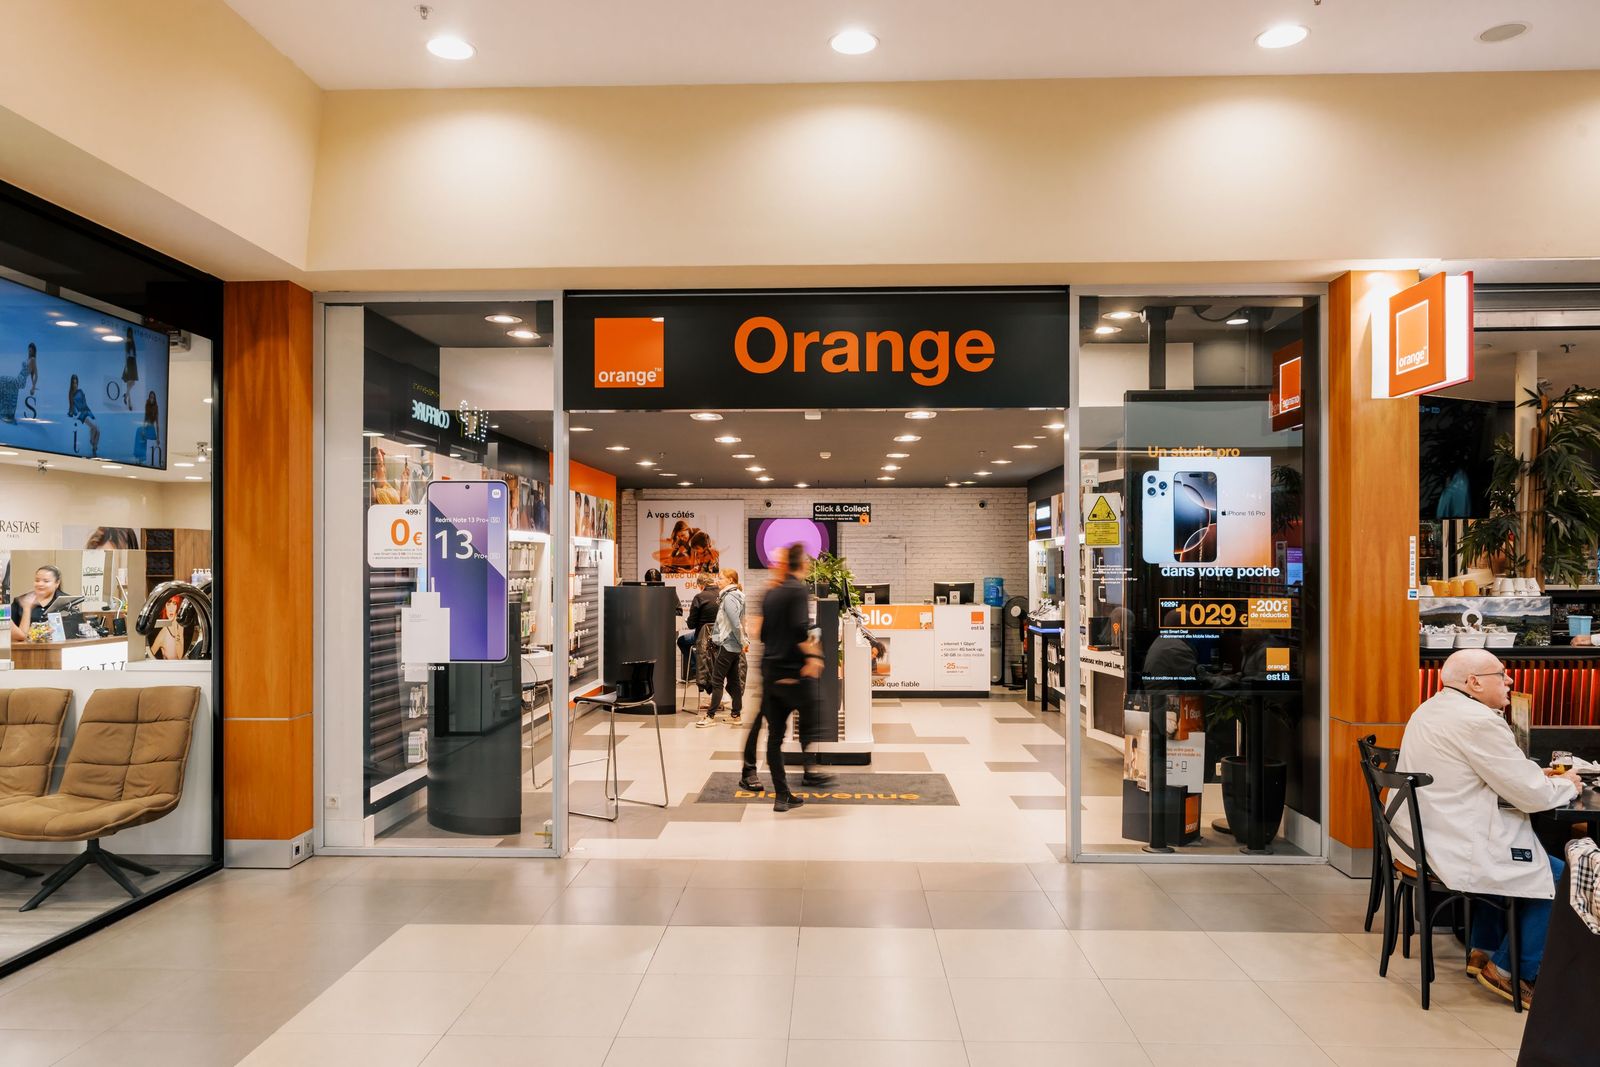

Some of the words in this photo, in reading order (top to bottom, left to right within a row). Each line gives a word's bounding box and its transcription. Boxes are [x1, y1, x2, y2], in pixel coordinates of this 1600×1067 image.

[734, 316, 996, 387] Orange
[1399, 350, 1424, 368] orange
[598, 369, 657, 386] orange
[1148, 445, 1165, 457] Un
[1170, 445, 1213, 457] studio
[1217, 447, 1240, 459] pro
[646, 509, 653, 518] À
[655, 511, 670, 519] vos
[671, 510, 695, 519] côtés
[815, 505, 834, 513] Click
[843, 505, 870, 513] Collect
[434, 529, 474, 560] 13
[1161, 566, 1195, 577] dans
[1198, 567, 1233, 577] votre
[1237, 565, 1280, 579] poche
[1251, 600, 1282, 612] -200
[861, 610, 893, 626] ello
[1175, 603, 1237, 626] 1029
[1239, 613, 1248, 625] €
[1266, 673, 1281, 681] est
[1282, 672, 1290, 680] là
[901, 680, 920, 688] fiable
